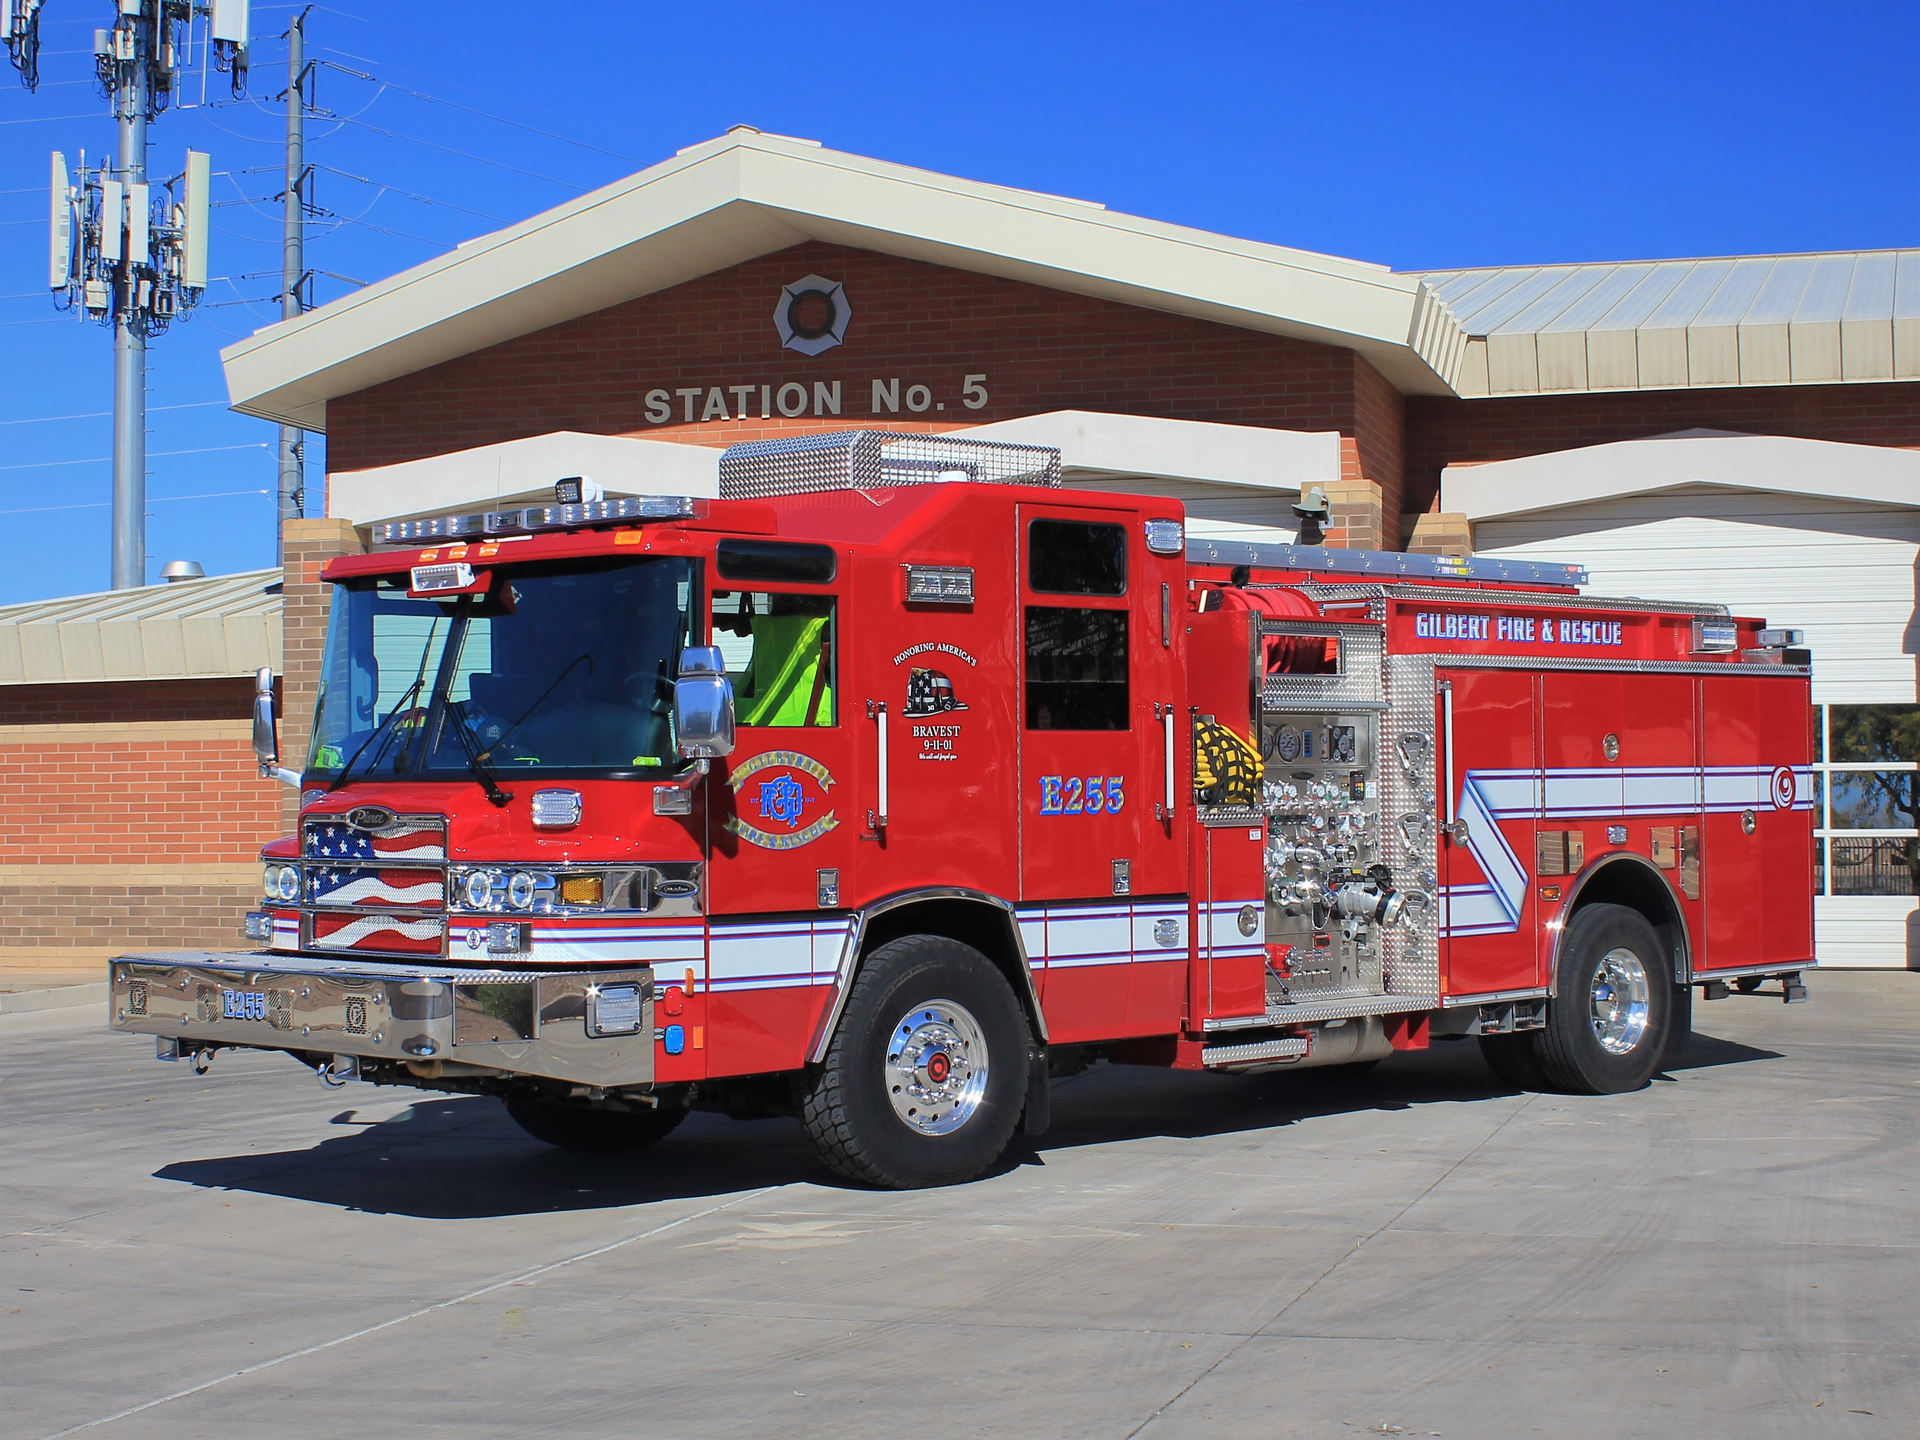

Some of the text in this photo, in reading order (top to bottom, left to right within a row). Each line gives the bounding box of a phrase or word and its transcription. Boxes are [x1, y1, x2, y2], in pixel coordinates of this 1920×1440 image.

[644, 374, 989, 424] STATION No. 5
[1416, 612, 1622, 645] GILBERT FIRE & RESCUE
[893, 642, 978, 667] HONORING AMERICA'S
[912, 725, 961, 737] BRAVEST
[923, 739, 953, 750] 9-11-01
[748, 752, 816, 772] GILBERT
[1039, 775, 1125, 815] E255
[355, 809, 385, 825] Pierce
[738, 822, 764, 845] FIRE
[781, 821, 825, 847] RESCUE
[223, 989, 266, 1020] E255
